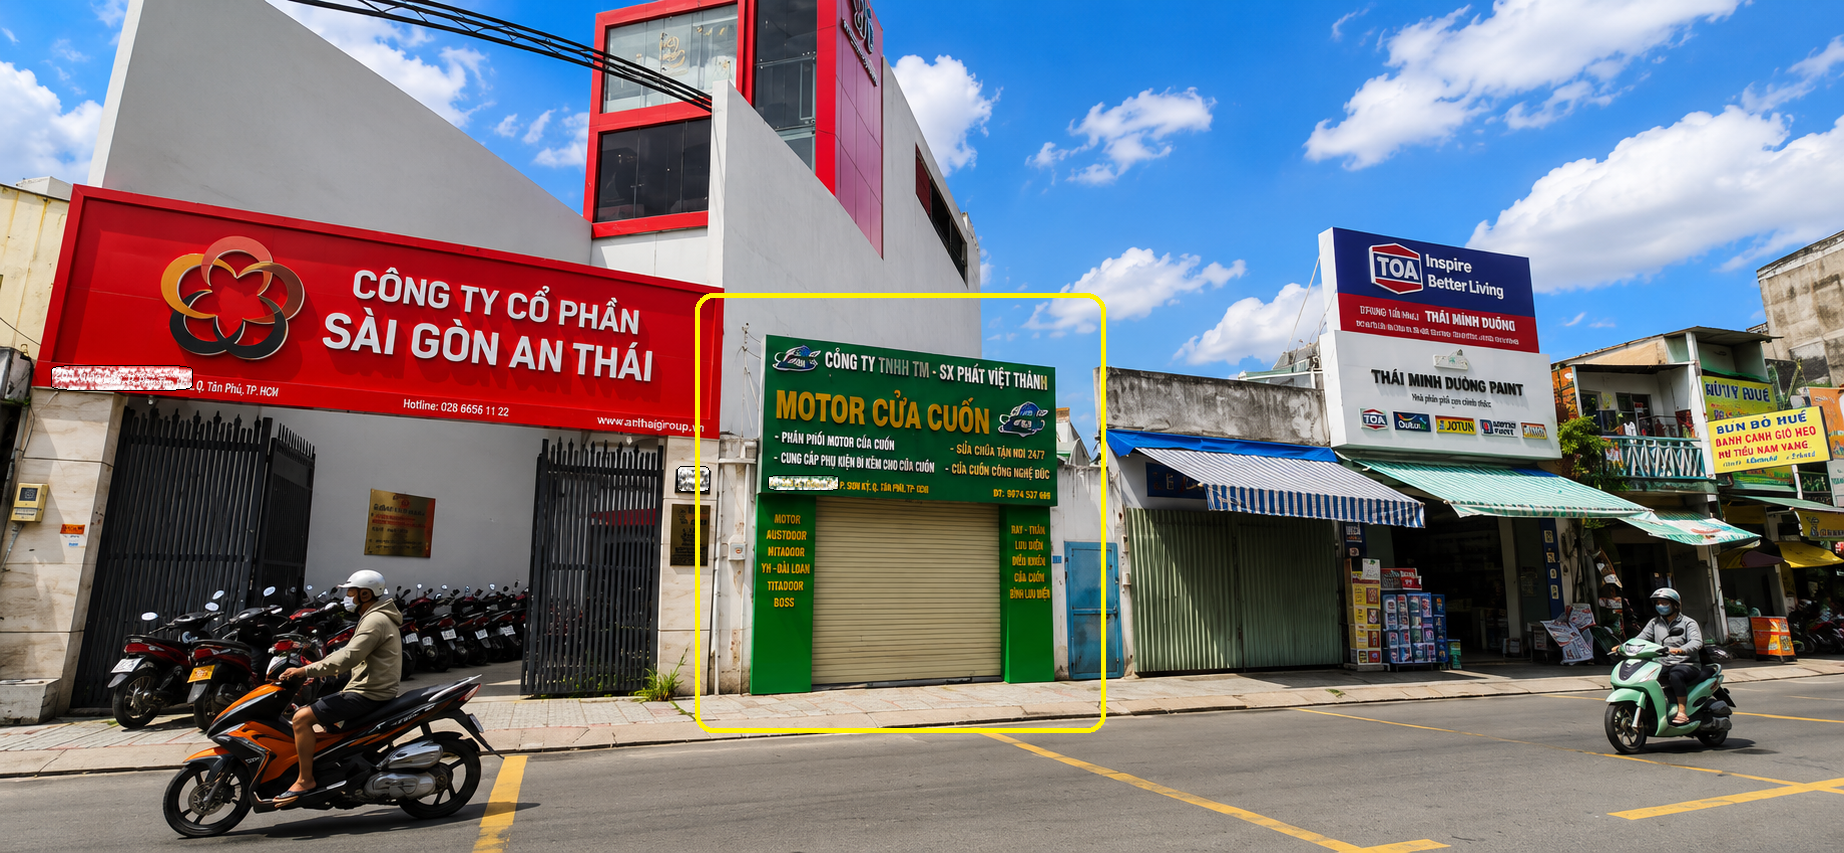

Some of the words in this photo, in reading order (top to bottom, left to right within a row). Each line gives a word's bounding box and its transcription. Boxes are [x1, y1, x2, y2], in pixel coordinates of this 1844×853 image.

[1376, 255, 1419, 281] TOA
[1425, 253, 1472, 274] Inspire
[1428, 274, 1467, 292] Better
[1469, 279, 1504, 300] Living
[352, 266, 450, 309] CÔNG
[461, 284, 500, 315] TY
[507, 285, 550, 323] CỔ
[558, 297, 640, 335] PHẦN
[322, 307, 397, 355] SÀI
[411, 319, 499, 366] GÒN
[509, 335, 564, 373] AN
[572, 341, 653, 382] THÁI
[861, 355, 876, 373] TY
[878, 357, 909, 376] TNHH
[912, 361, 929, 378] TM
[940, 363, 955, 381] SX
[957, 363, 985, 384] PHÁT
[246, 384, 259, 396] TP.
[1371, 368, 1404, 386] THÁI
[1408, 372, 1442, 390] MINH
[1489, 381, 1523, 397] PAINT
[403, 398, 439, 412] Hotline:
[441, 402, 458, 412] 028
[460, 403, 483, 415] 6656
[486, 405, 496, 416] 11
[498, 406, 509, 417] 22
[776, 389, 866, 426] MOTOR
[872, 390, 922, 430] CỬA
[927, 397, 990, 435] CUỐN
[1364, 414, 1386, 425] TOA
[1447, 420, 1475, 432] JOTUN
[827, 435, 854, 448] MOTOR
[1745, 431, 1772, 444] CANH
[1795, 425, 1816, 437] HEO
[781, 452, 802, 465] CUNG
[1757, 443, 1779, 455] NAM
[774, 514, 801, 524] MOTOR
[761, 563, 771, 574] YH
[791, 563, 810, 574] LOAN
[774, 597, 795, 608] BOSS
